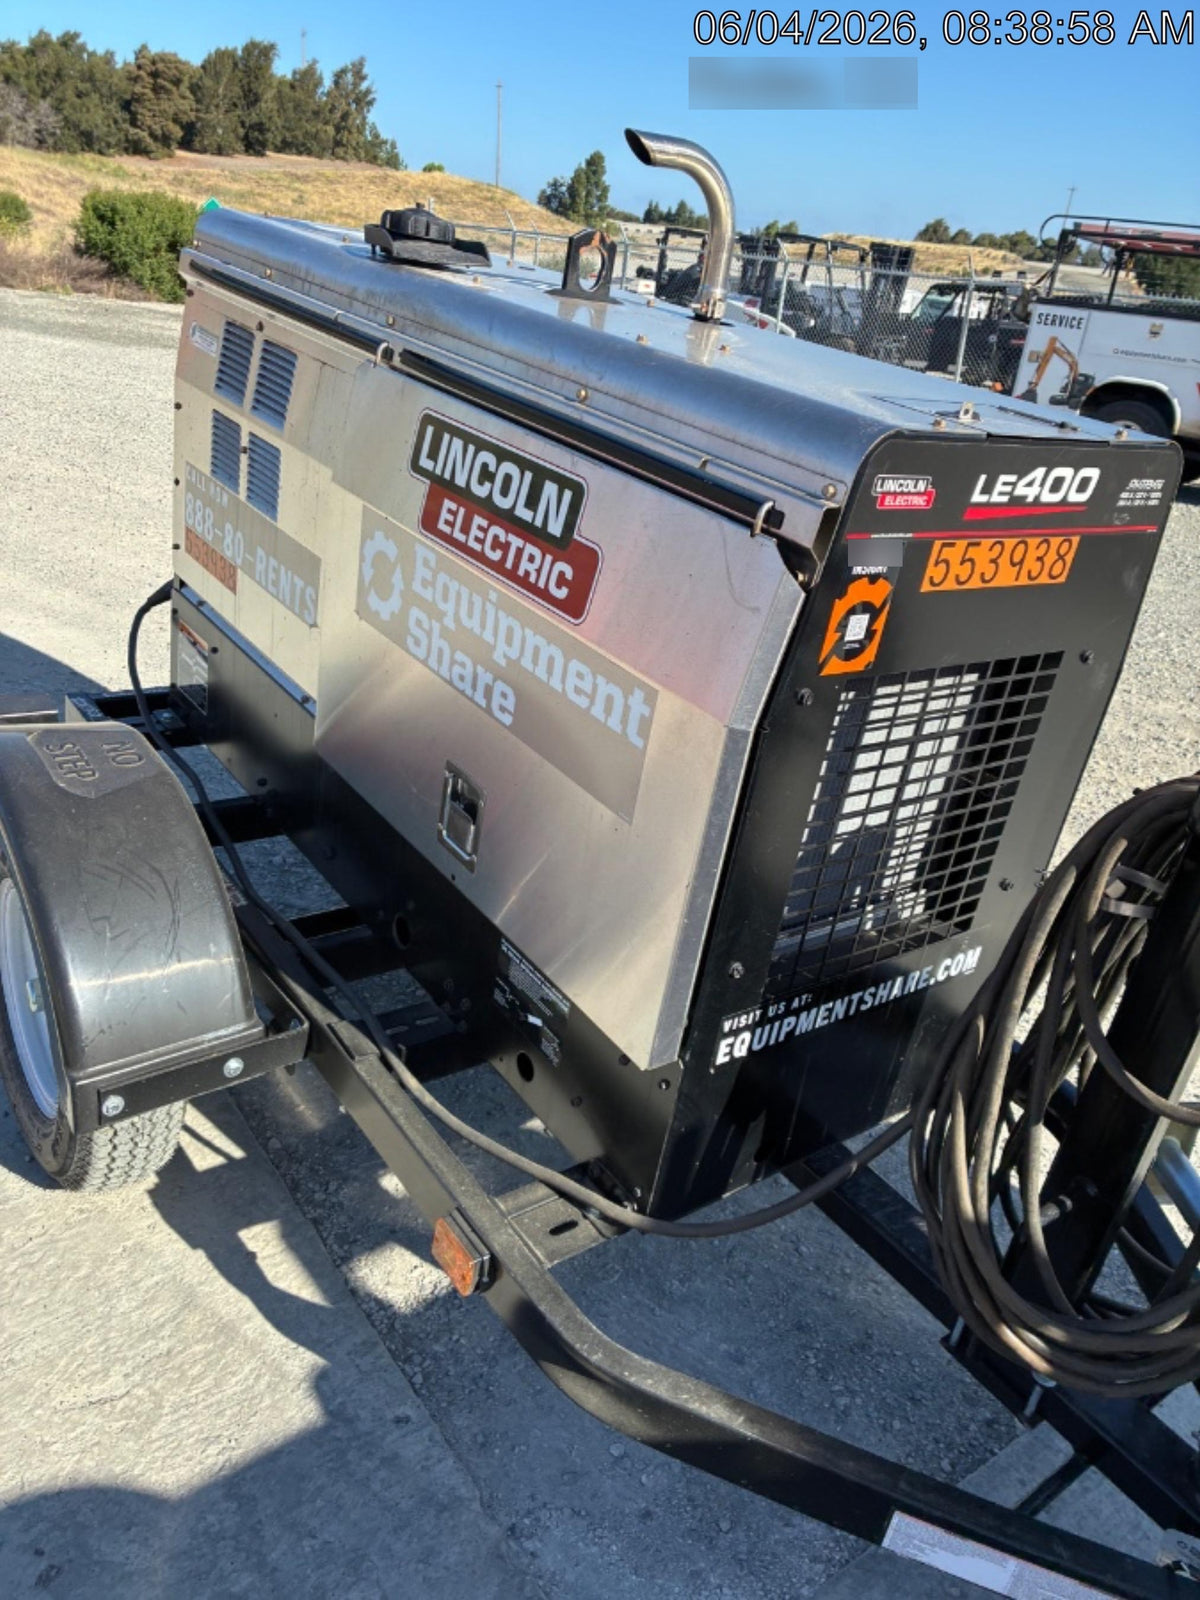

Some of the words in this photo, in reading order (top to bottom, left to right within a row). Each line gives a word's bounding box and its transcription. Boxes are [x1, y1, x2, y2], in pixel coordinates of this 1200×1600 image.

[1036, 311, 1085, 331] SERVICE
[418, 424, 573, 538] LINCOLN
[876, 479, 927, 493] LINCOLN
[884, 495, 928, 506] ELECTRIC
[970, 466, 1101, 503] LE400
[185, 492, 317, 626] 888-80-RENTS
[437, 498, 574, 600] ELECTRIC
[928, 538, 1073, 588] 553938
[406, 605, 517, 727] Share
[411, 543, 650, 750] Equipment
[43, 742, 99, 782] STEP
[101, 741, 146, 768] NO
[715, 946, 982, 1066] EQUIPMENTSHARE.COM
[723, 1009, 763, 1034] VISIT
[767, 1000, 785, 1017] US
[791, 993, 814, 1010] AT:
